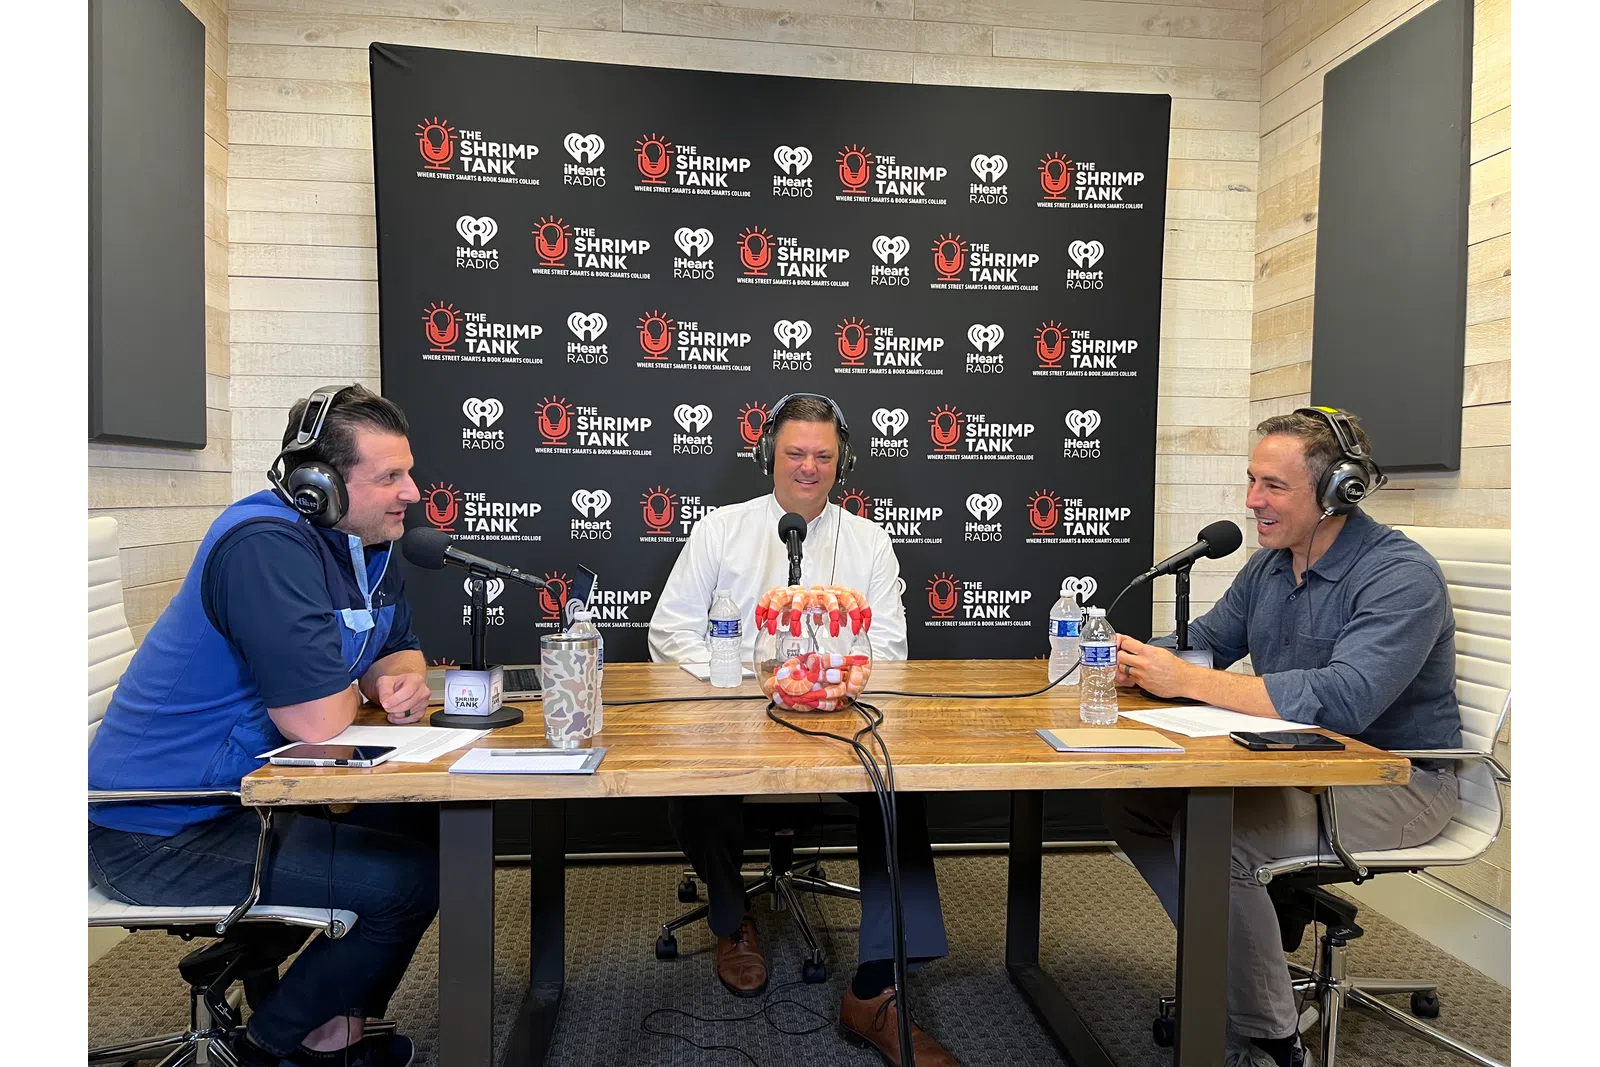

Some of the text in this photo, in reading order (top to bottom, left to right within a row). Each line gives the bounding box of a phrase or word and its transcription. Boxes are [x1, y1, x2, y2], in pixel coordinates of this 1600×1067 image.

[459, 130, 481, 140] THE
[460, 140, 539, 159] SHRIMP
[676, 145, 696, 154] THE
[676, 155, 750, 172] SHRIMP
[876, 156, 895, 164] THE
[460, 157, 515, 175] TANK
[564, 164, 605, 176] iHeart
[1076, 162, 1095, 170] THE
[876, 165, 947, 181] SHRIMP
[1076, 172, 1144, 185] SHRIMP
[564, 175, 605, 187] RADIO
[676, 171, 728, 187] TANK
[774, 176, 812, 187] iHeart
[774, 187, 812, 197] RADIO
[875, 180, 925, 196] TANK
[970, 183, 1007, 194] iHeart
[1075, 187, 1122, 200] TANK
[970, 194, 1008, 204] RADIO
[574, 228, 595, 236] THE
[575, 237, 650, 254] SHRIMP
[777, 238, 797, 246] THE
[457, 246, 498, 259] iHeart
[970, 244, 989, 252] THE
[778, 247, 850, 262] SHRIMP
[970, 252, 1039, 267] SHRIMP
[457, 258, 499, 269] RADIO
[574, 253, 627, 269] TANK
[674, 257, 714, 269] iHeart
[674, 269, 714, 279] RADIO
[777, 262, 827, 278] TANK
[872, 265, 909, 276] iHeart
[969, 268, 1017, 282] TANK
[1067, 269, 1103, 280] iHeart
[871, 276, 910, 286] RADIO
[1067, 280, 1103, 289] RADIO
[465, 313, 486, 322] THE
[466, 322, 542, 339] SHRIMP
[677, 322, 698, 330] THE
[874, 328, 893, 336] THE
[678, 331, 751, 347] SHRIMP
[874, 337, 944, 351] SHRIMP
[465, 339, 519, 354] TANK
[568, 342, 608, 354] iHeart
[1071, 340, 1138, 353] SHRIMP
[568, 354, 608, 364] RADIO
[678, 347, 728, 362] TANK
[774, 350, 811, 360] iHeart
[873, 352, 922, 366] TANK
[967, 353, 1003, 363] iHeart
[773, 361, 812, 370] RADIO
[1070, 355, 1117, 368] TANK
[966, 364, 1003, 373] RADIO
[576, 407, 597, 415] THE
[577, 416, 652, 431] SHRIMP
[463, 428, 504, 439] iHeart
[966, 424, 1034, 437] SHRIMP
[577, 432, 629, 446] TANK
[674, 434, 712, 444] iHeart
[871, 437, 908, 447] iHeart
[1065, 438, 1100, 448] iHeart
[463, 440, 504, 450] RADIO
[674, 445, 713, 454] RADIO
[966, 439, 1013, 452] TANK
[871, 448, 908, 457] RADIO
[1064, 449, 1100, 458] RADIO
[464, 493, 486, 501] THE
[680, 496, 700, 504] THE
[874, 498, 892, 506] THE
[465, 502, 541, 516] SHRIMP
[874, 507, 942, 520] SHRIMP
[1064, 508, 1130, 520] SHRIMP
[464, 518, 518, 532] TANK
[572, 519, 611, 530] iHeart
[966, 522, 1002, 532] iHeart
[1063, 522, 1110, 535] TANK
[571, 530, 611, 539] RADIO
[965, 532, 1002, 541] RADIO
[590, 591, 652, 604] HRIMP
[964, 591, 1031, 604] SHRIMP
[591, 606, 629, 619] ANK
[963, 605, 1010, 618] TANK
